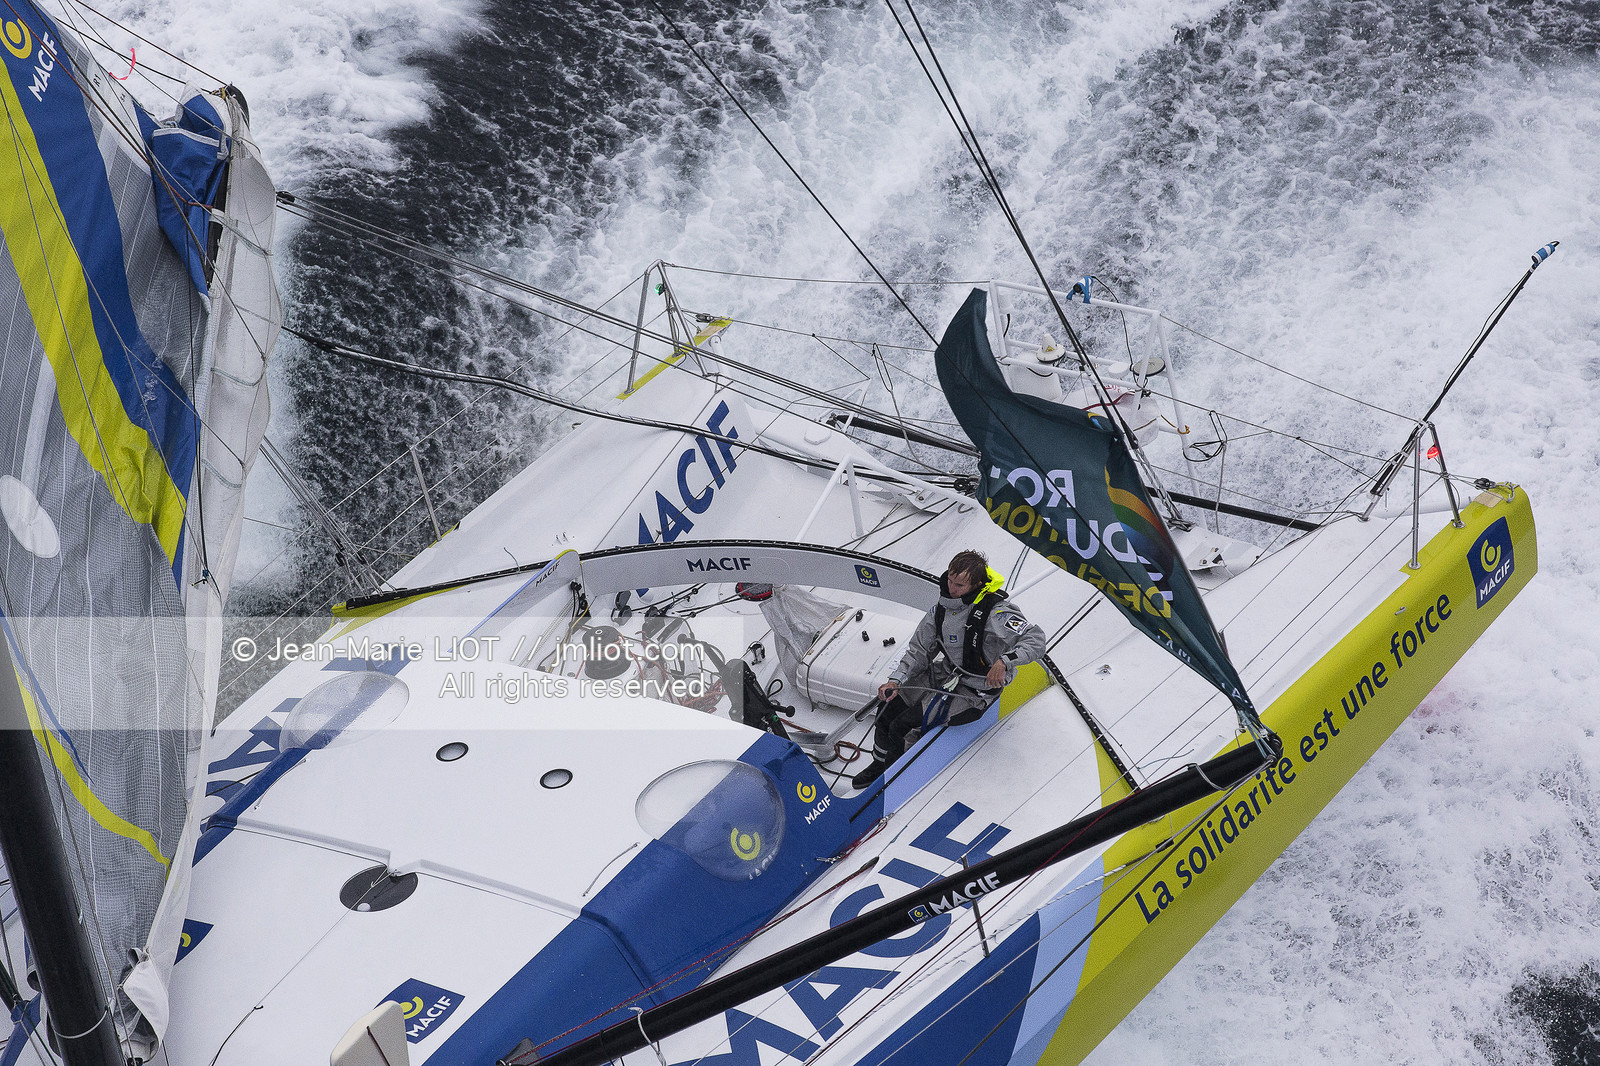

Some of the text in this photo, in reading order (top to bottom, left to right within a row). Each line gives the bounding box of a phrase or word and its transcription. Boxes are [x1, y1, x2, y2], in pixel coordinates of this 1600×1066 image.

[27, 31, 57, 102] MACIF
[535, 560, 560, 587] MACIF
[686, 558, 751, 573] MACIF
[860, 577, 878, 586] MACIF
[1480, 559, 1511, 601] MACIF
[1134, 880, 1175, 924] La
[1175, 747, 1297, 889] solidarité
[1299, 707, 1341, 763] est
[1341, 661, 1389, 720] une
[1390, 594, 1453, 669] force
[804, 795, 831, 825] MACIF
[928, 871, 1000, 915] MACIF
[406, 995, 451, 1038] MACIF
